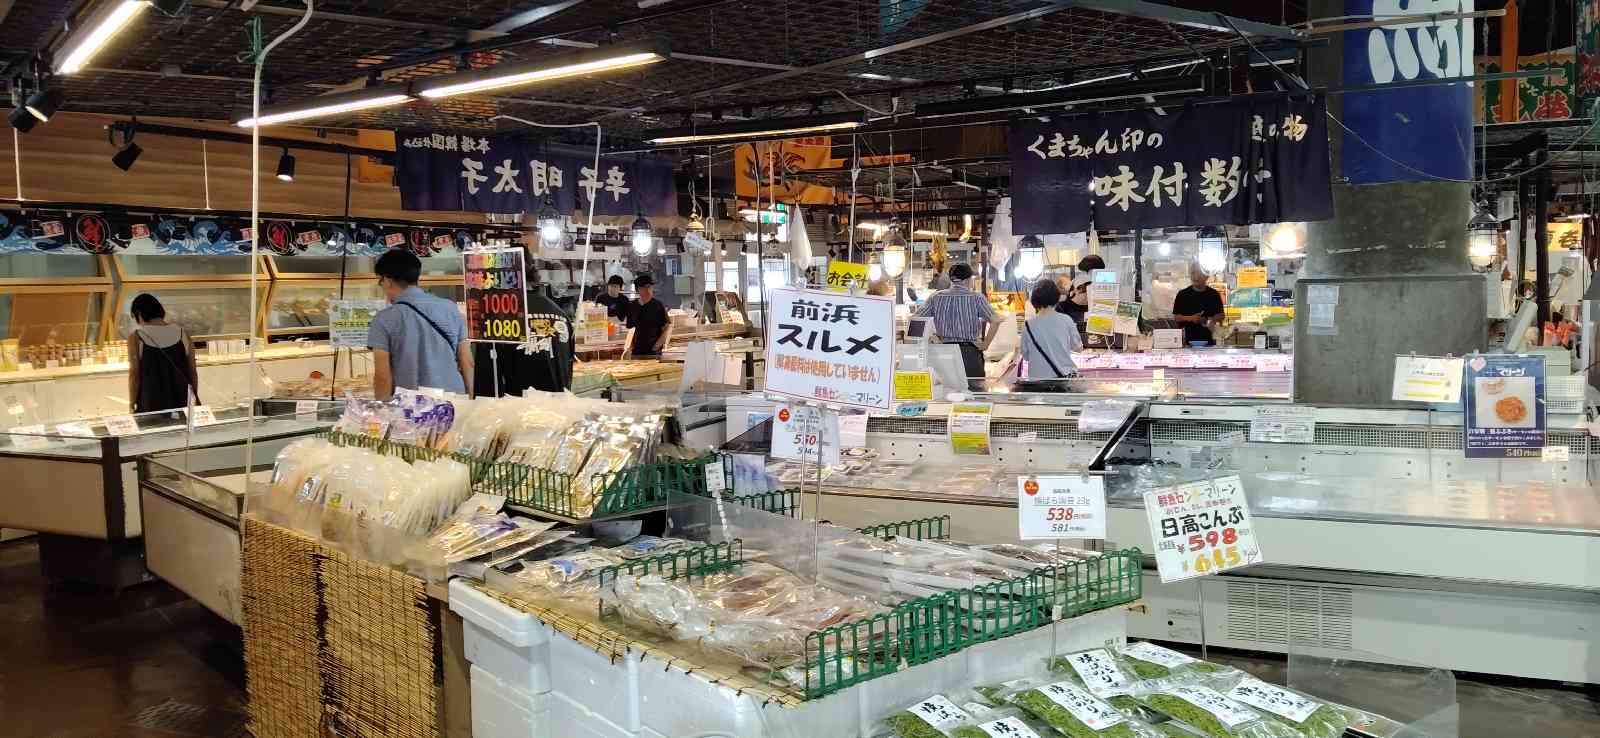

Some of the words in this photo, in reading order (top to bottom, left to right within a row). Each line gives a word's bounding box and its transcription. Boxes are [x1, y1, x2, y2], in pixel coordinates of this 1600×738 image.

[1027, 127, 1164, 159] くまちゃん印の
[1093, 156, 1272, 211] 味付数
[827, 270, 867, 288] お会計
[483, 294, 519, 314] 1000
[791, 299, 860, 325] 前浜
[484, 319, 521, 338] 1080
[776, 323, 883, 356] スルメ
[1046, 507, 1074, 521] 538
[1160, 505, 1246, 539] 日高こんぶ
[1051, 523, 1069, 533] 581
